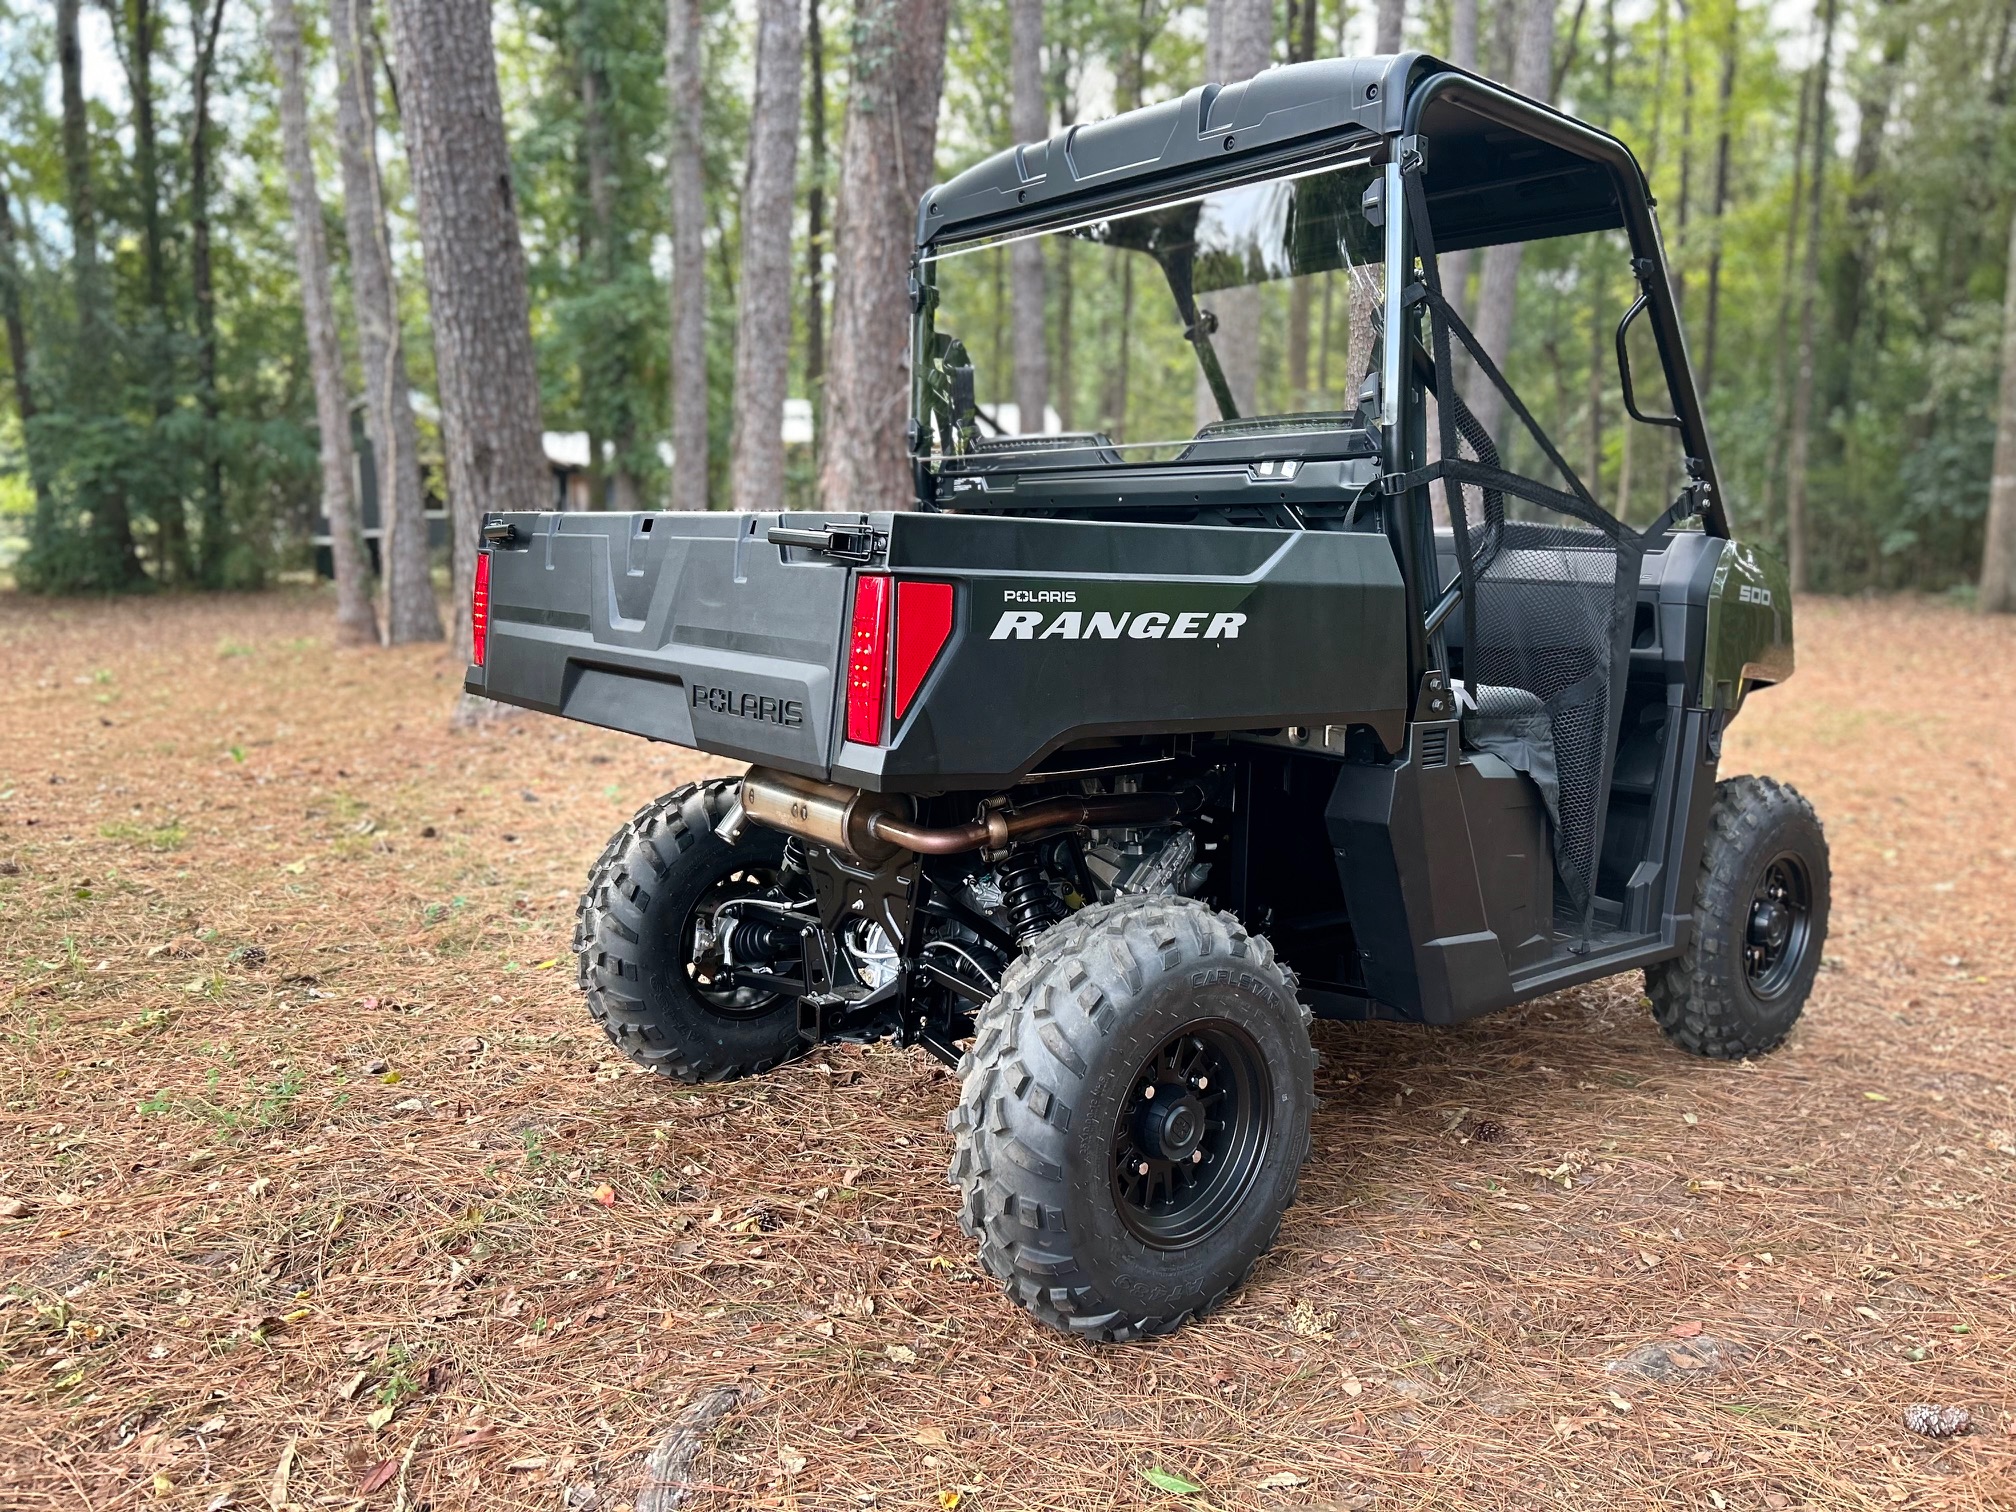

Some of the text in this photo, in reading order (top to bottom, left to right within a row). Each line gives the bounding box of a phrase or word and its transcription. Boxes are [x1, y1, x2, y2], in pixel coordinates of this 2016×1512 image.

[1004, 590, 1077, 603] POLARIS
[1739, 585, 1771, 606] 500
[989, 610, 1248, 640] RANGER
[692, 684, 803, 729] POLARIS
